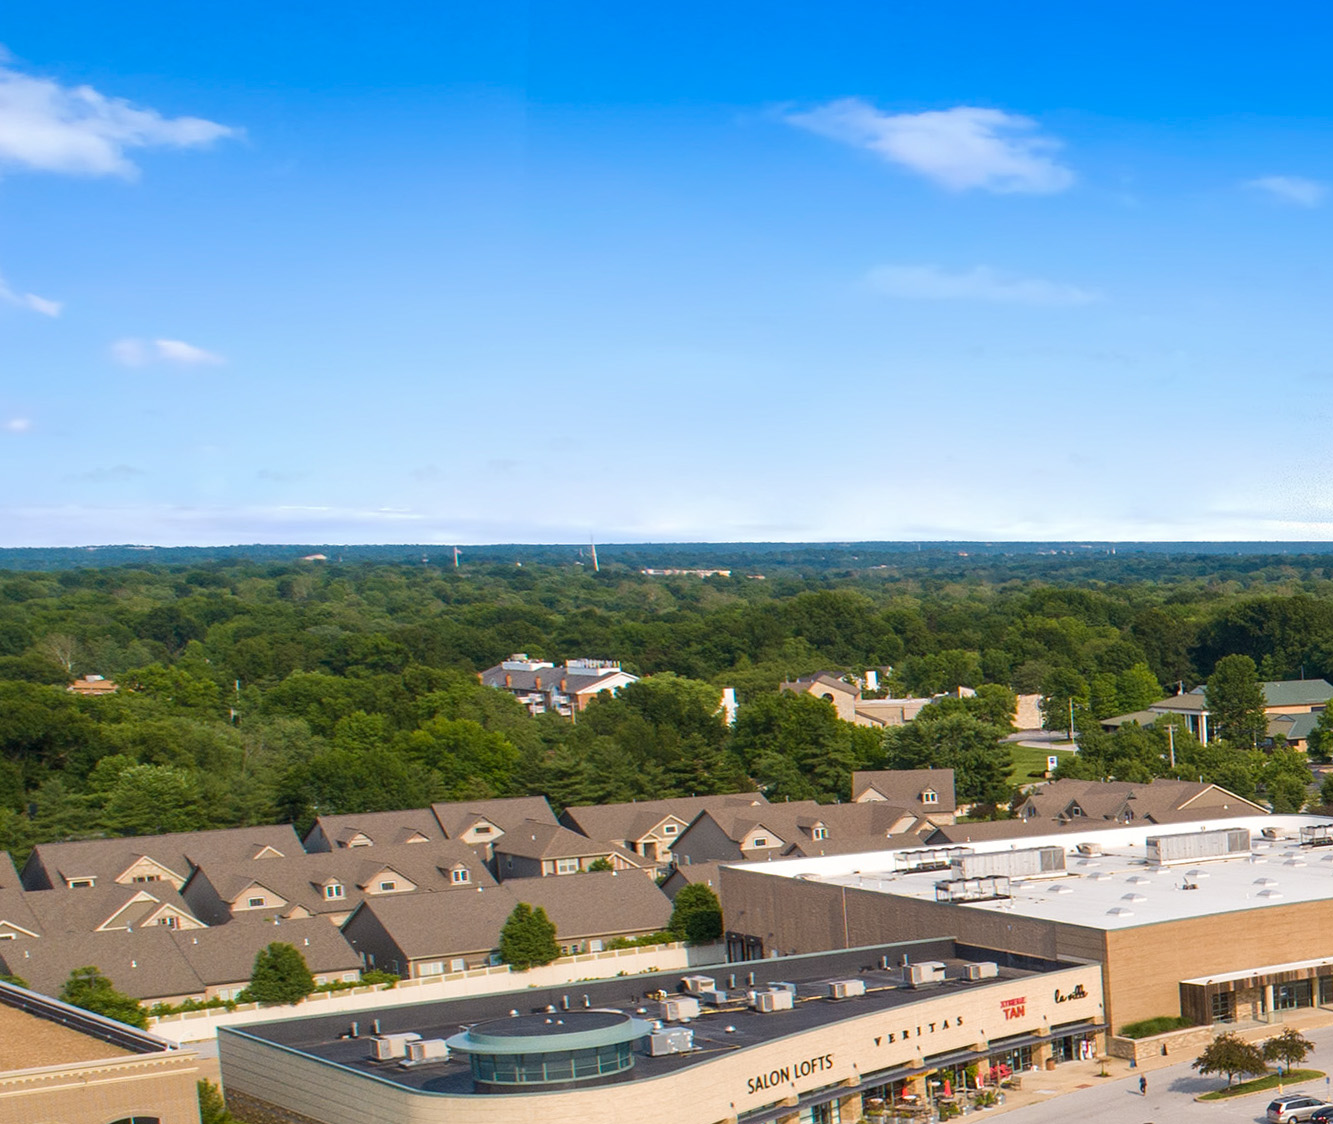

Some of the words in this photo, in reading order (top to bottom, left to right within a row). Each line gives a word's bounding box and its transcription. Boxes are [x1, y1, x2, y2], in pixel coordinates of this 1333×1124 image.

[1003, 1005, 1025, 1020] TAN
[874, 1016, 963, 1047] VERITAS
[747, 1066, 790, 1094] SALON
[794, 1053, 833, 1079] LOFTS
